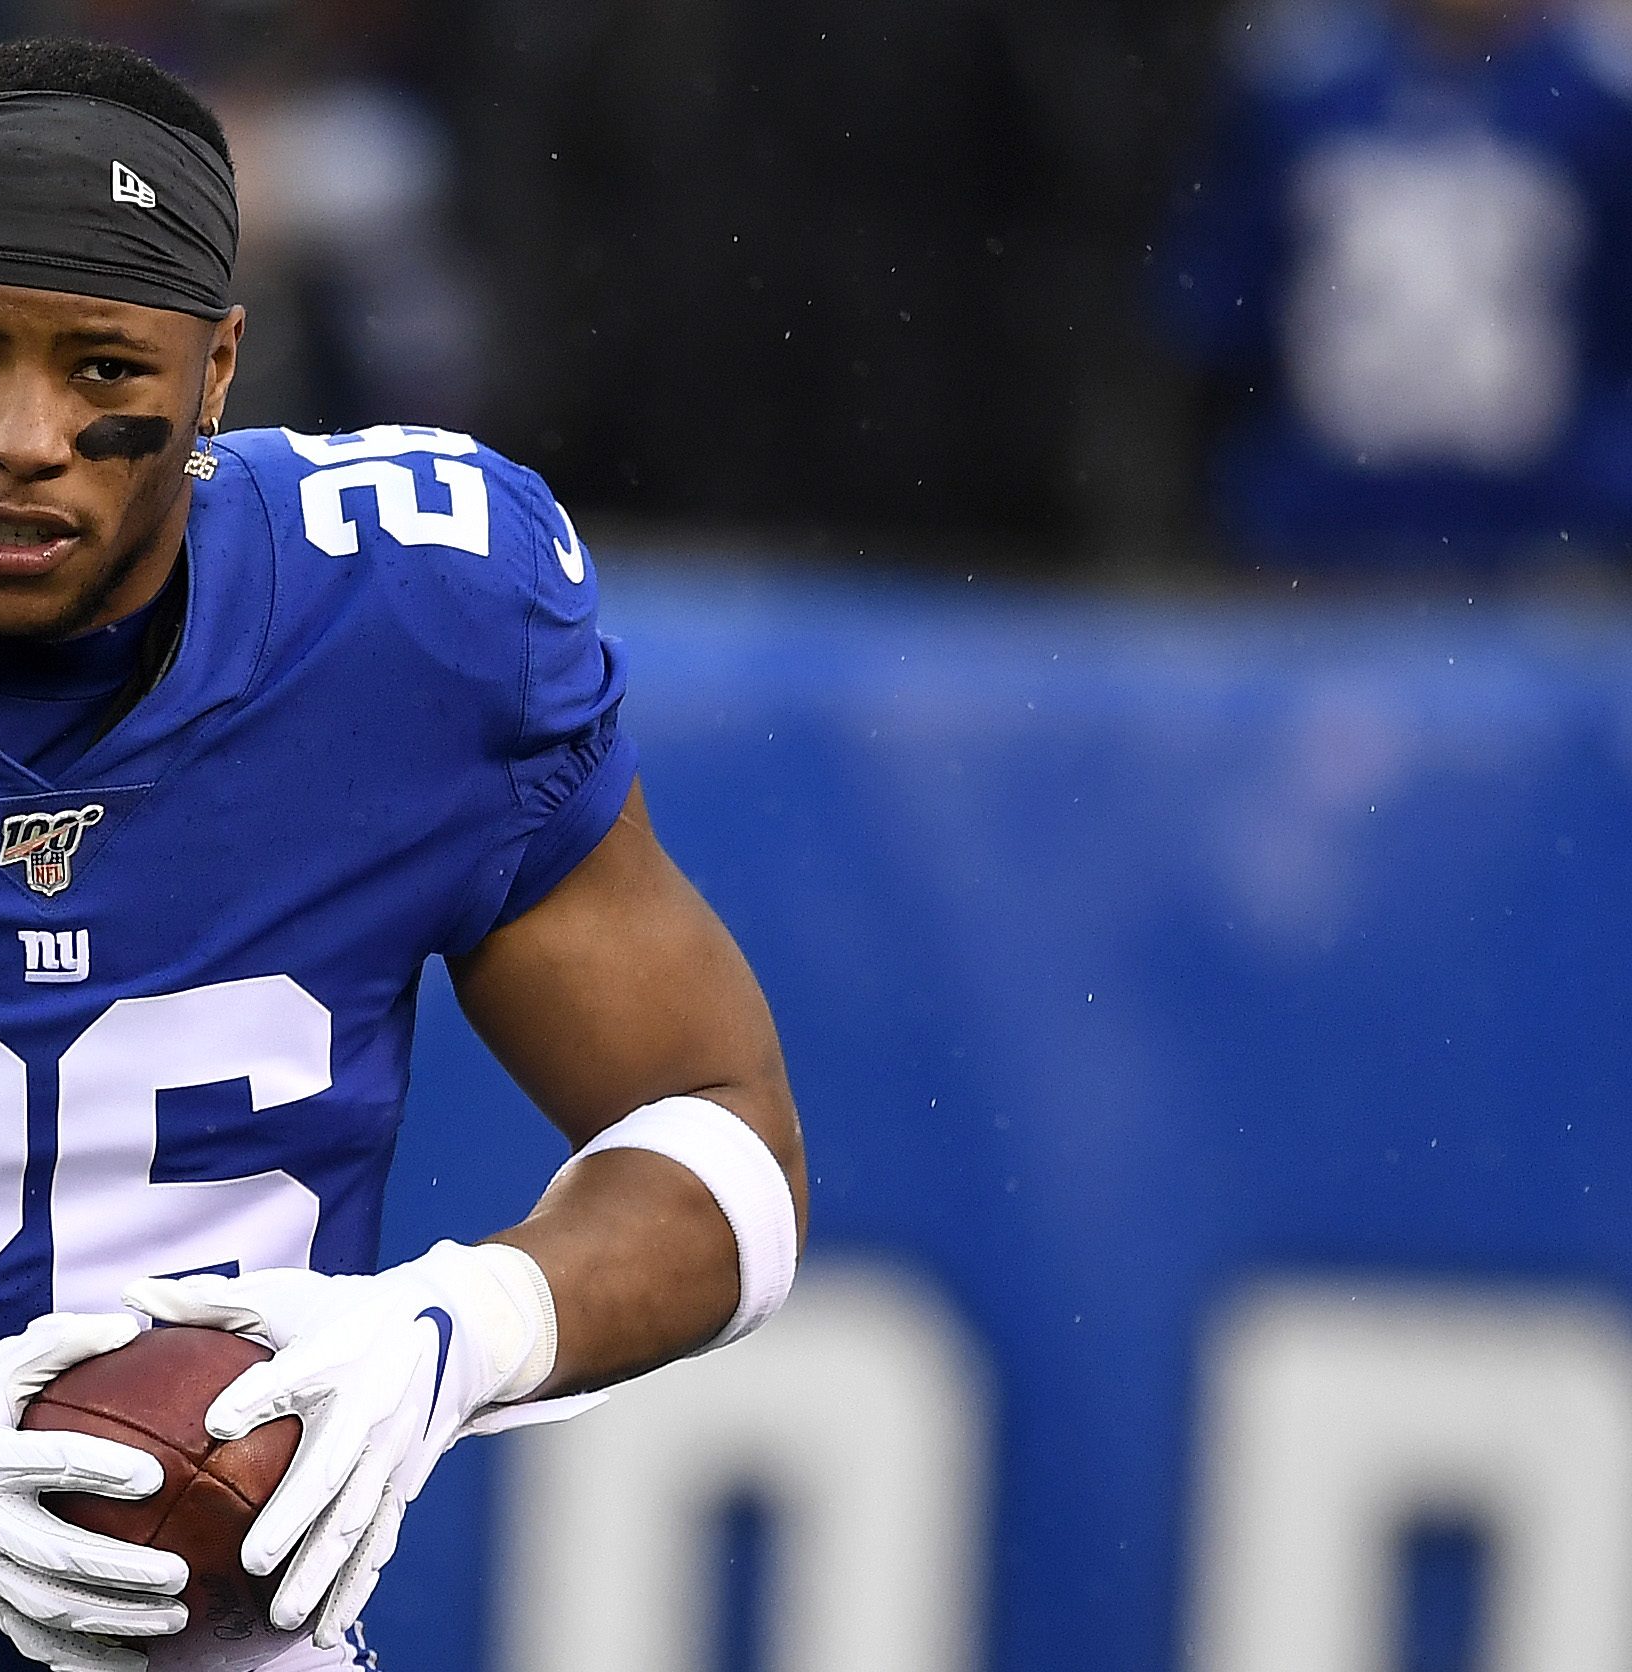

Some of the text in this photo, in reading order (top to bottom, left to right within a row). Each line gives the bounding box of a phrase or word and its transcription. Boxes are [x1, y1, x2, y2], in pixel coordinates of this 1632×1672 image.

[184, 451, 218, 480] 26
[2, 812, 84, 860] 100
[35, 865, 64, 885] NFL
